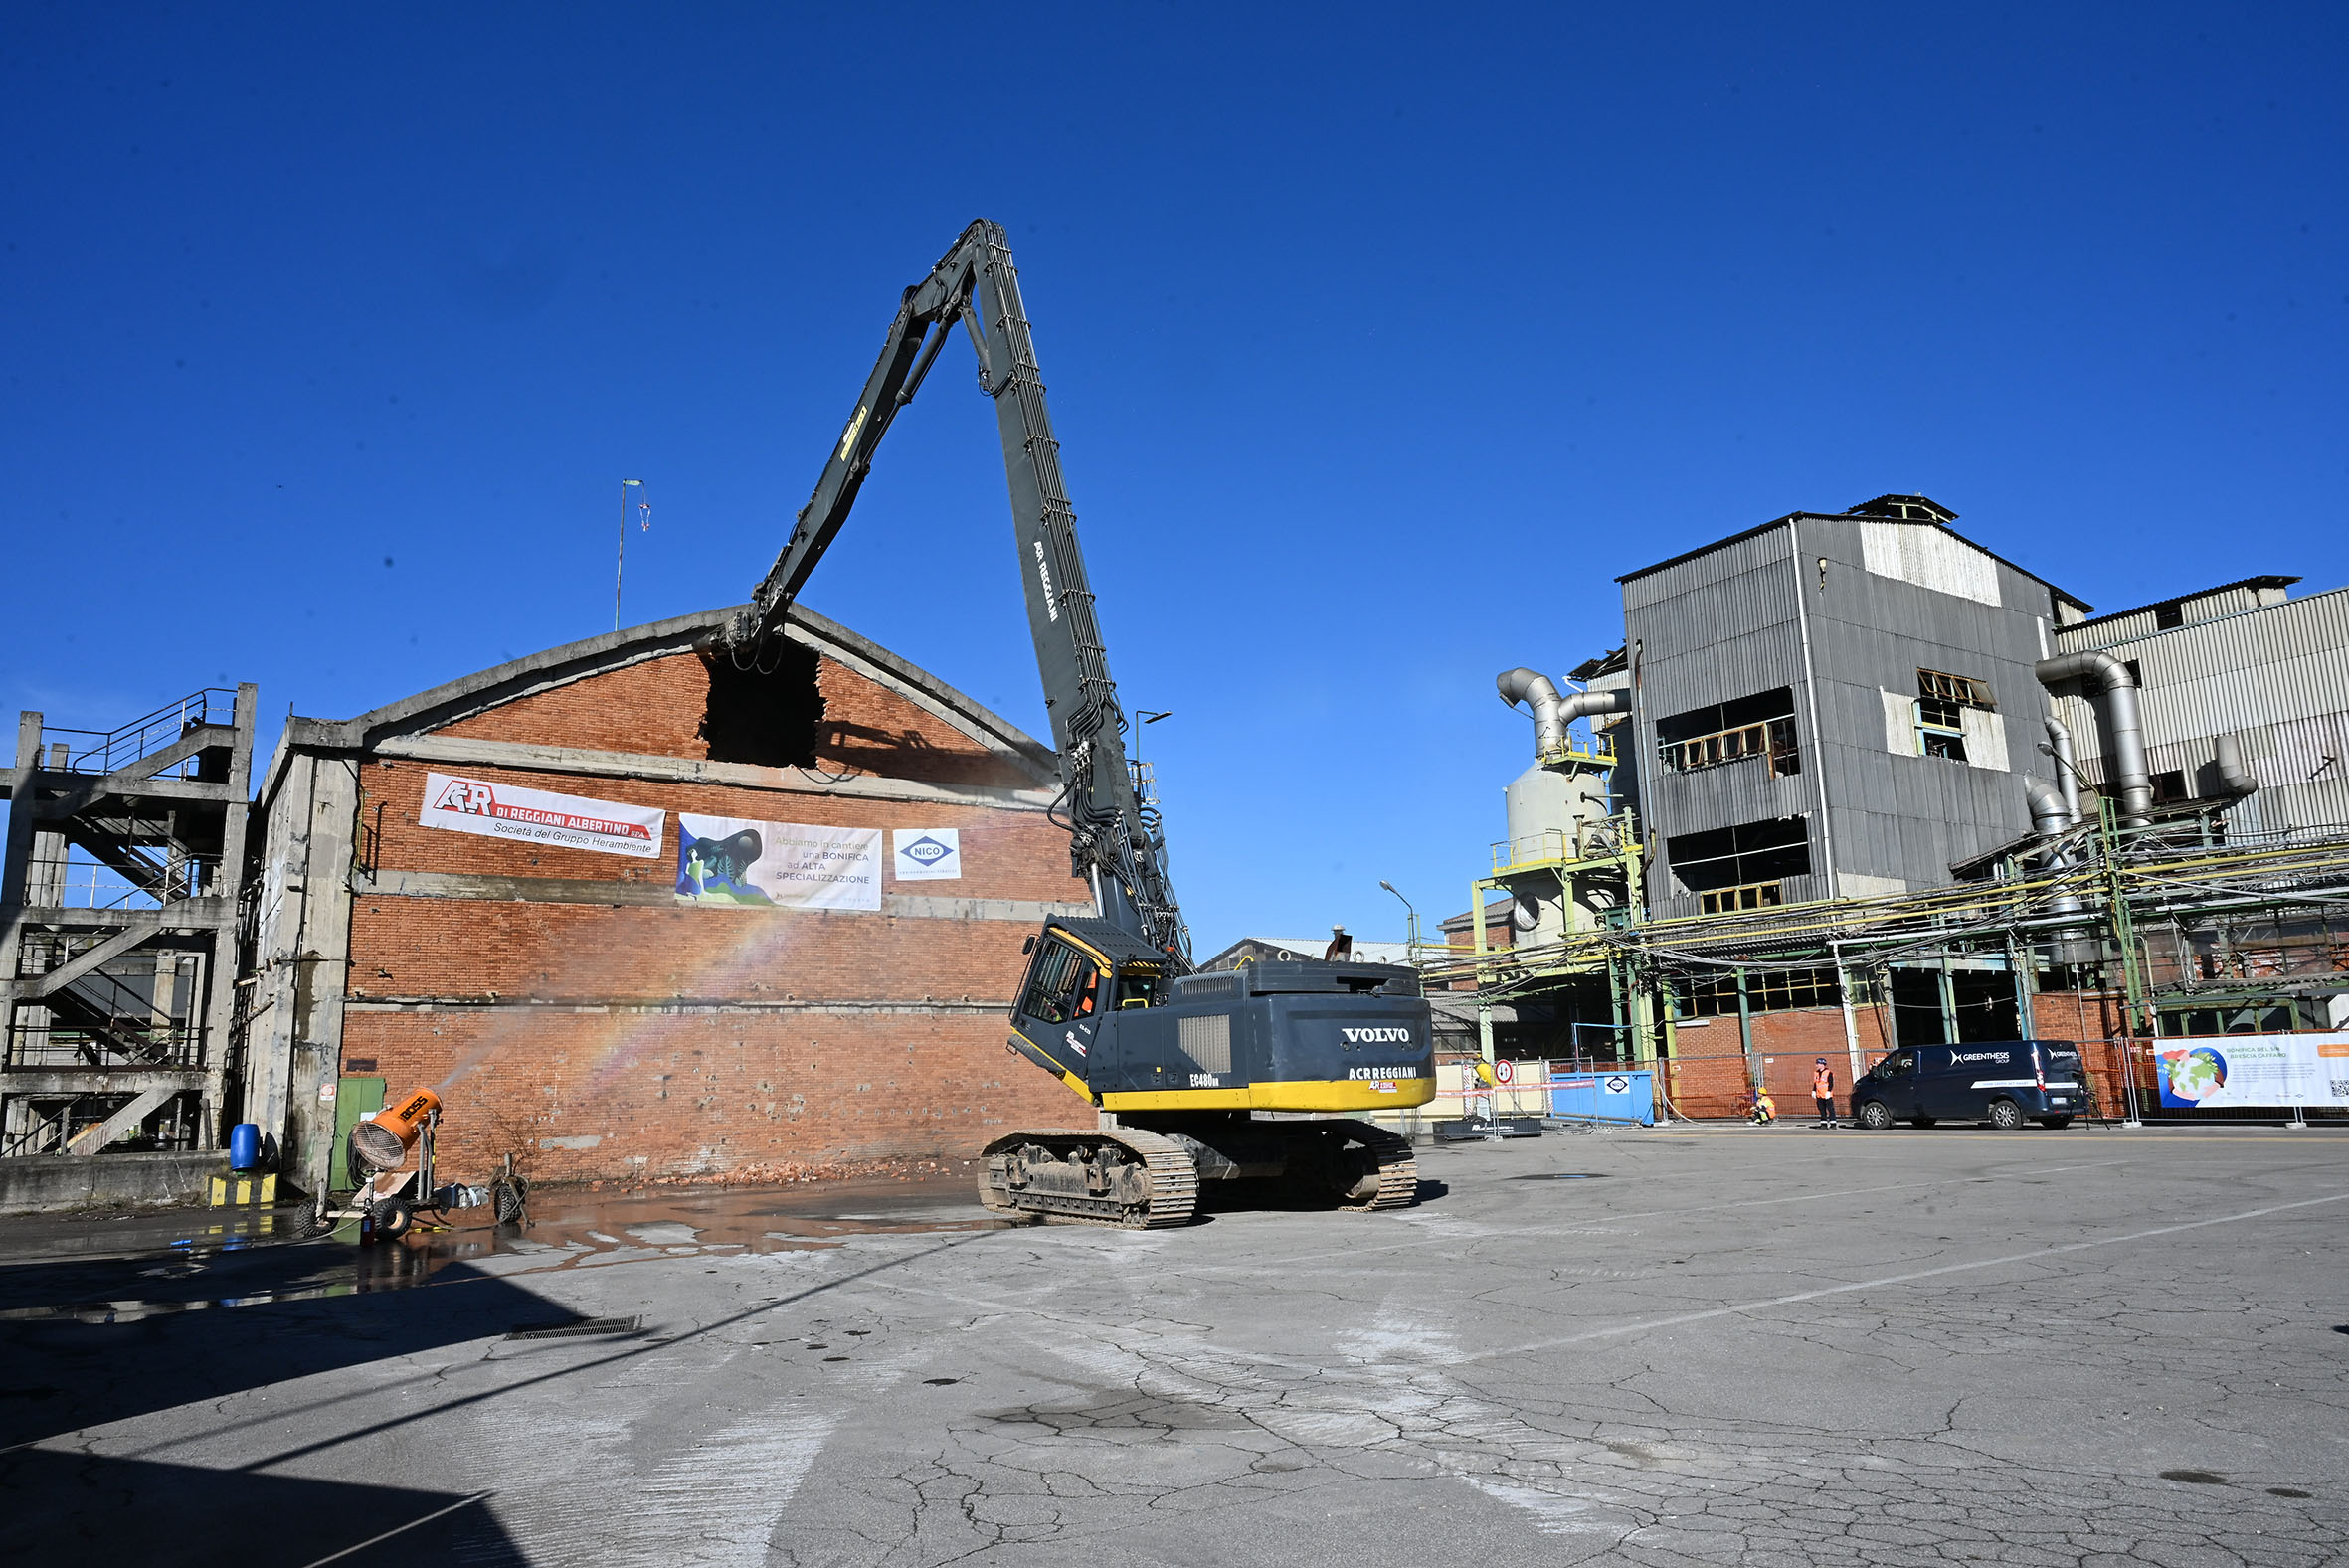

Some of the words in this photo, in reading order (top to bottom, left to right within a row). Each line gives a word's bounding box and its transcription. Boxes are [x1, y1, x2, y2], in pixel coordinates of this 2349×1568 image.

[1039, 561, 1058, 622] REGGIANI
[496, 807, 508, 818] DI
[510, 808, 565, 827] REGGIANI
[568, 817, 630, 834] ALBERTINO
[534, 830, 551, 839] del
[553, 832, 590, 845] Gruppo
[593, 837, 652, 853] Herambiente
[775, 837, 818, 848] Abbiamo
[831, 842, 868, 851] cantiere
[822, 852, 869, 861] BONIFICA
[914, 847, 941, 856] NICO
[776, 871, 870, 884] SPECIALIZZAZIONE
[1342, 1028, 1410, 1043] VOLVO
[1962, 1052, 2010, 1061] GREENTHESIS
[1372, 1066, 1417, 1080] REGGIANI
[400, 1096, 428, 1121] BOSS
